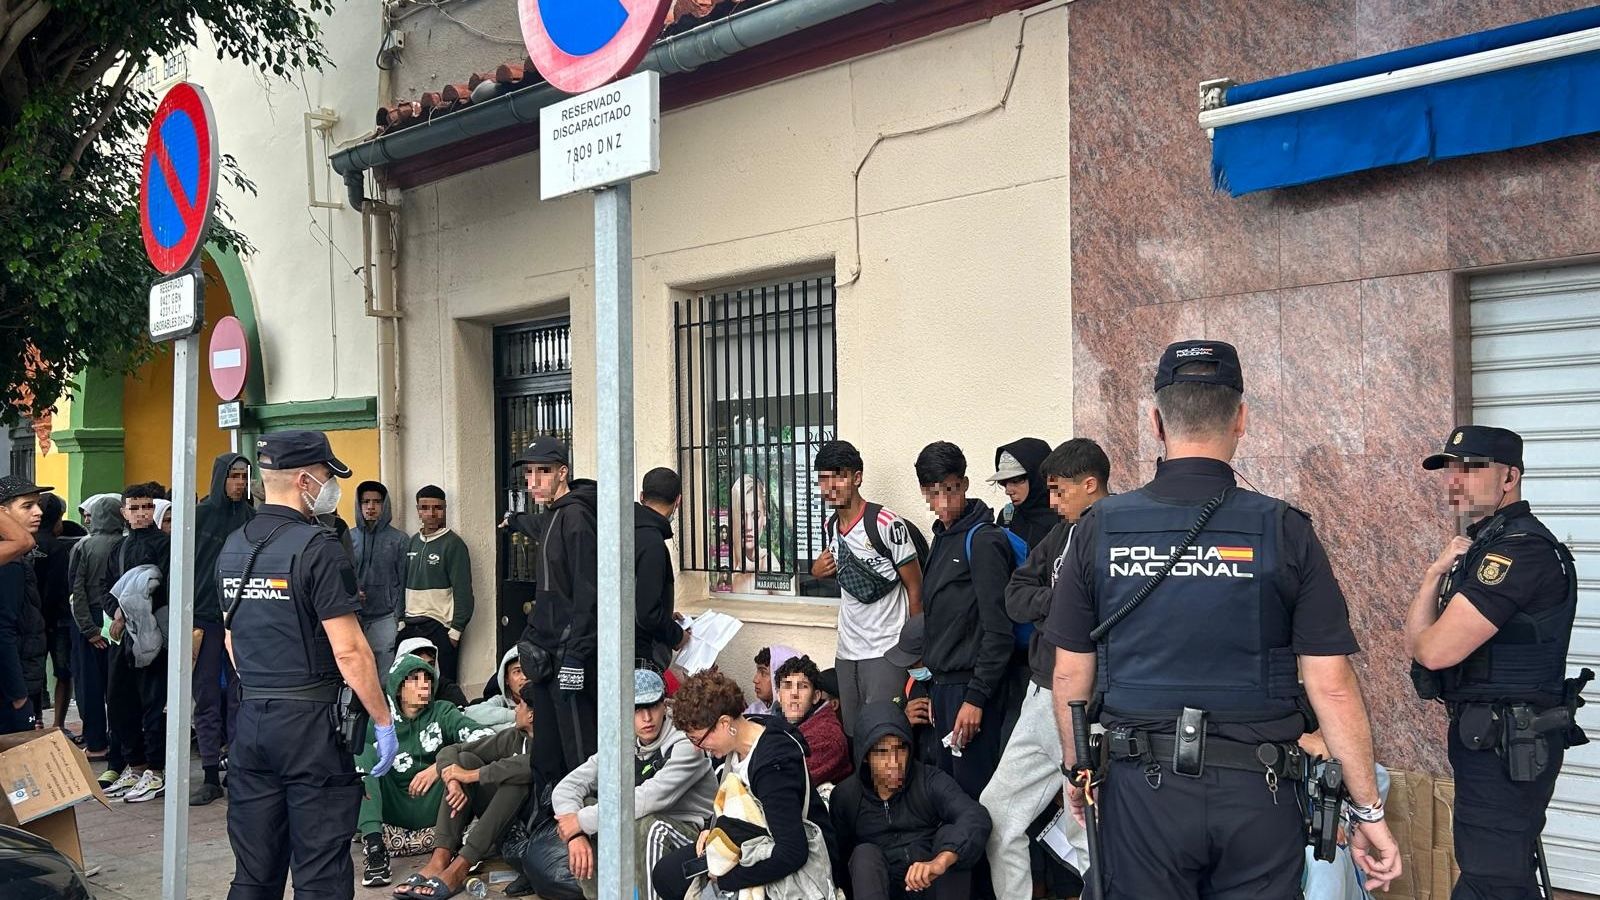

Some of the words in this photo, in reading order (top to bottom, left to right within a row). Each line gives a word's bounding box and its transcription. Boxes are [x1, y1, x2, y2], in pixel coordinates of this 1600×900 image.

[561, 90, 621, 121] RESERVADO
[553, 104, 631, 140] DISCAPACITADO
[566, 142, 592, 164] 7809
[598, 133, 622, 154] DNZ
[160, 277, 183, 293] RESERVADO
[1110, 562, 1253, 578] NACONAL
[757, 580, 789, 590] MARAVILLOSO
